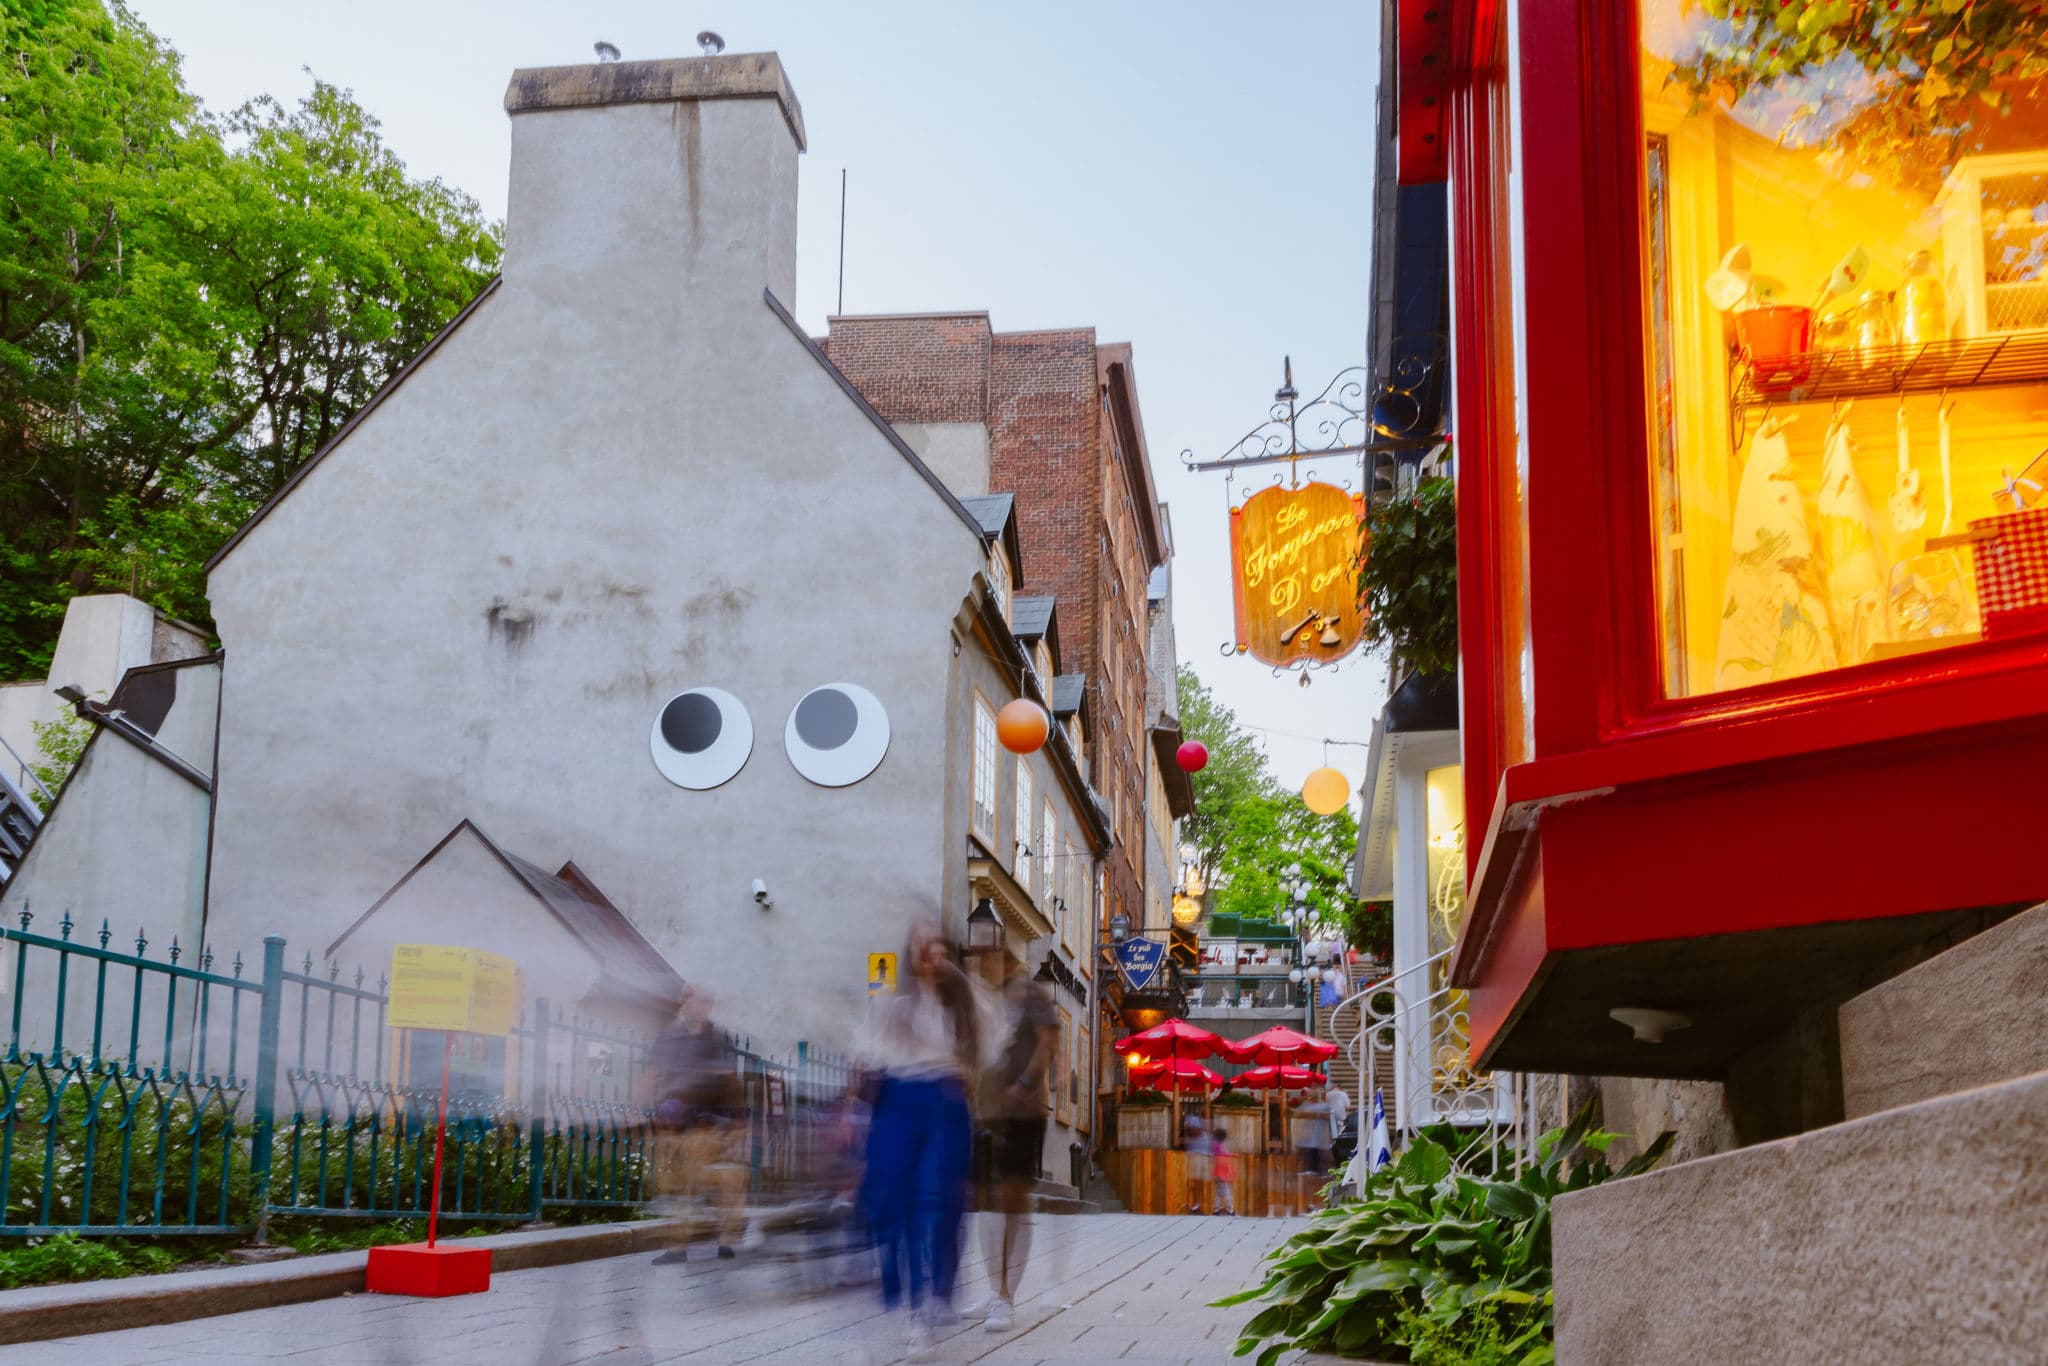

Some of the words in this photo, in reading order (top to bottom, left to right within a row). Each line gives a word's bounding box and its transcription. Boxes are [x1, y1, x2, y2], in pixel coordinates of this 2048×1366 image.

[1276, 502, 1309, 534] Le
[1245, 512, 1354, 588] Forgeron
[1138, 944, 1151, 953] pub
[1125, 962, 1153, 972] Borgia
